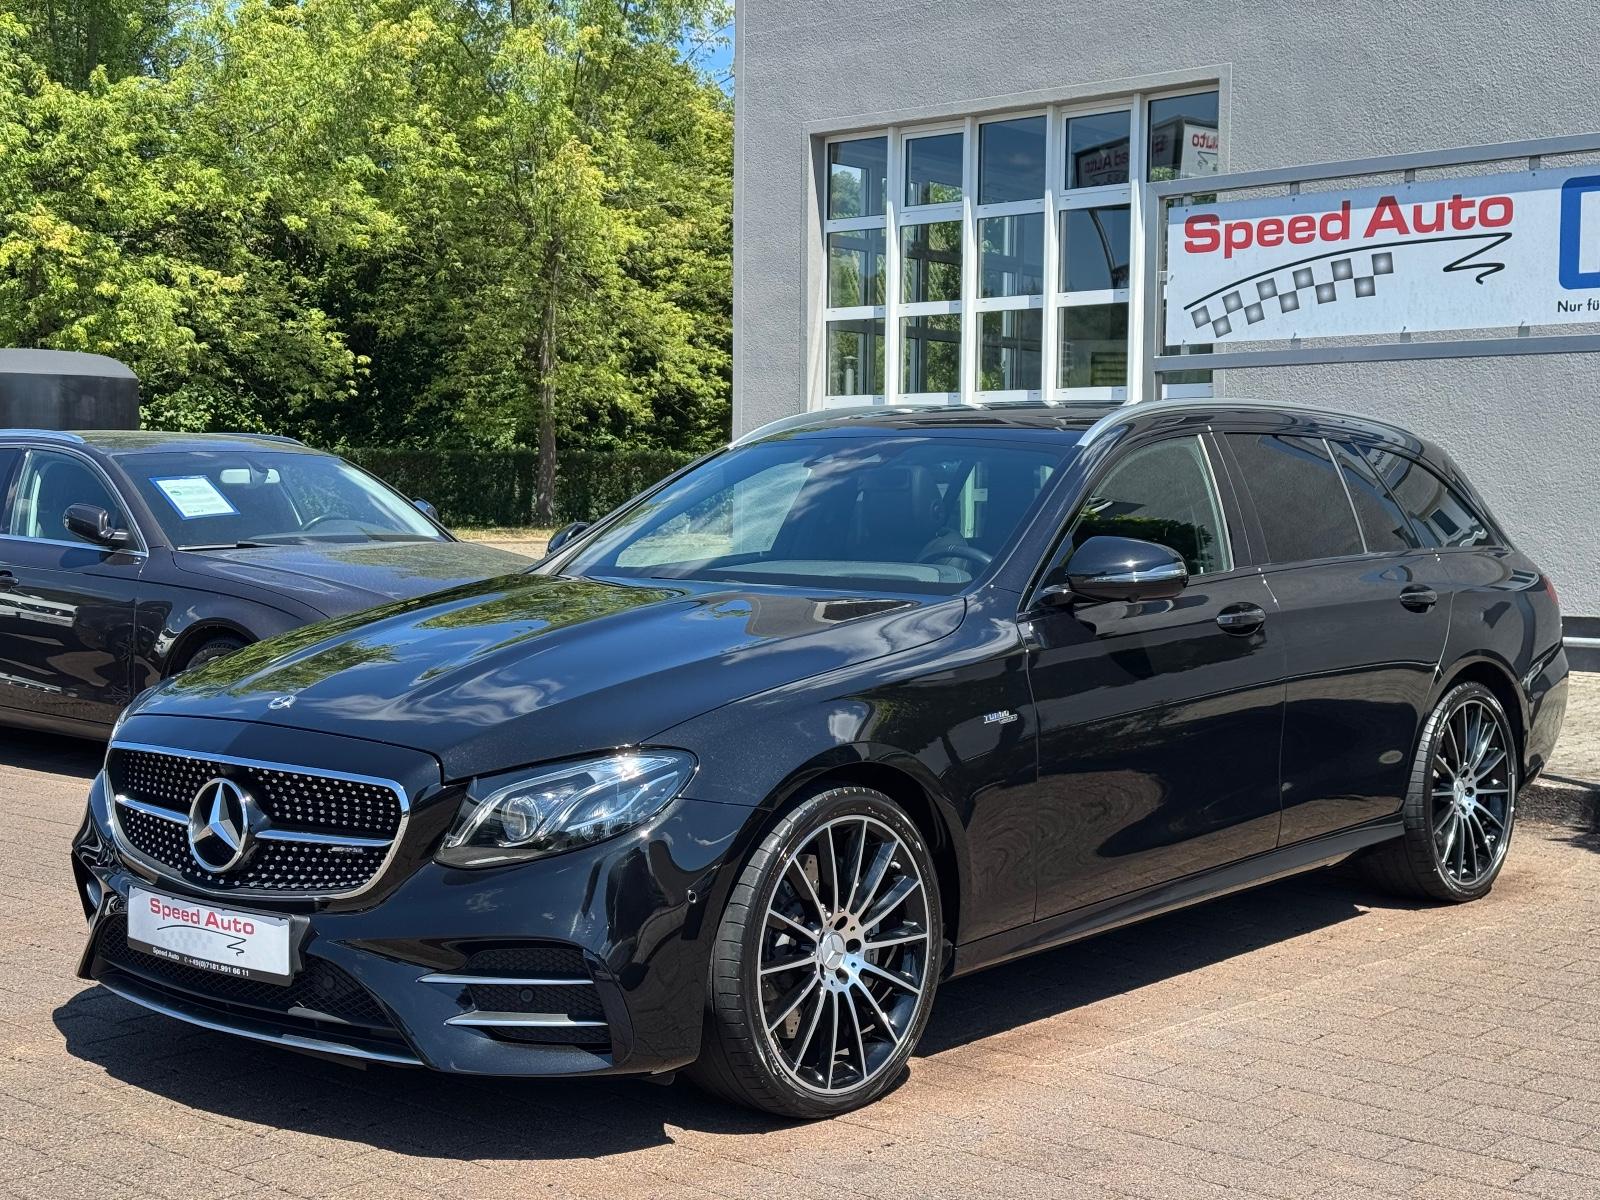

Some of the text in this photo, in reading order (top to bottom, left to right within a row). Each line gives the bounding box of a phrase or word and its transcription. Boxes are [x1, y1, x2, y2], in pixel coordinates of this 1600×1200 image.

[1184, 194, 1514, 259] Speed Auto
[1557, 300, 1583, 313] Nur
[150, 898, 255, 935] Speed Auto
[152, 946, 168, 958] Speed
[168, 951, 180, 961] Auto
[242, 969, 249, 977] 11
